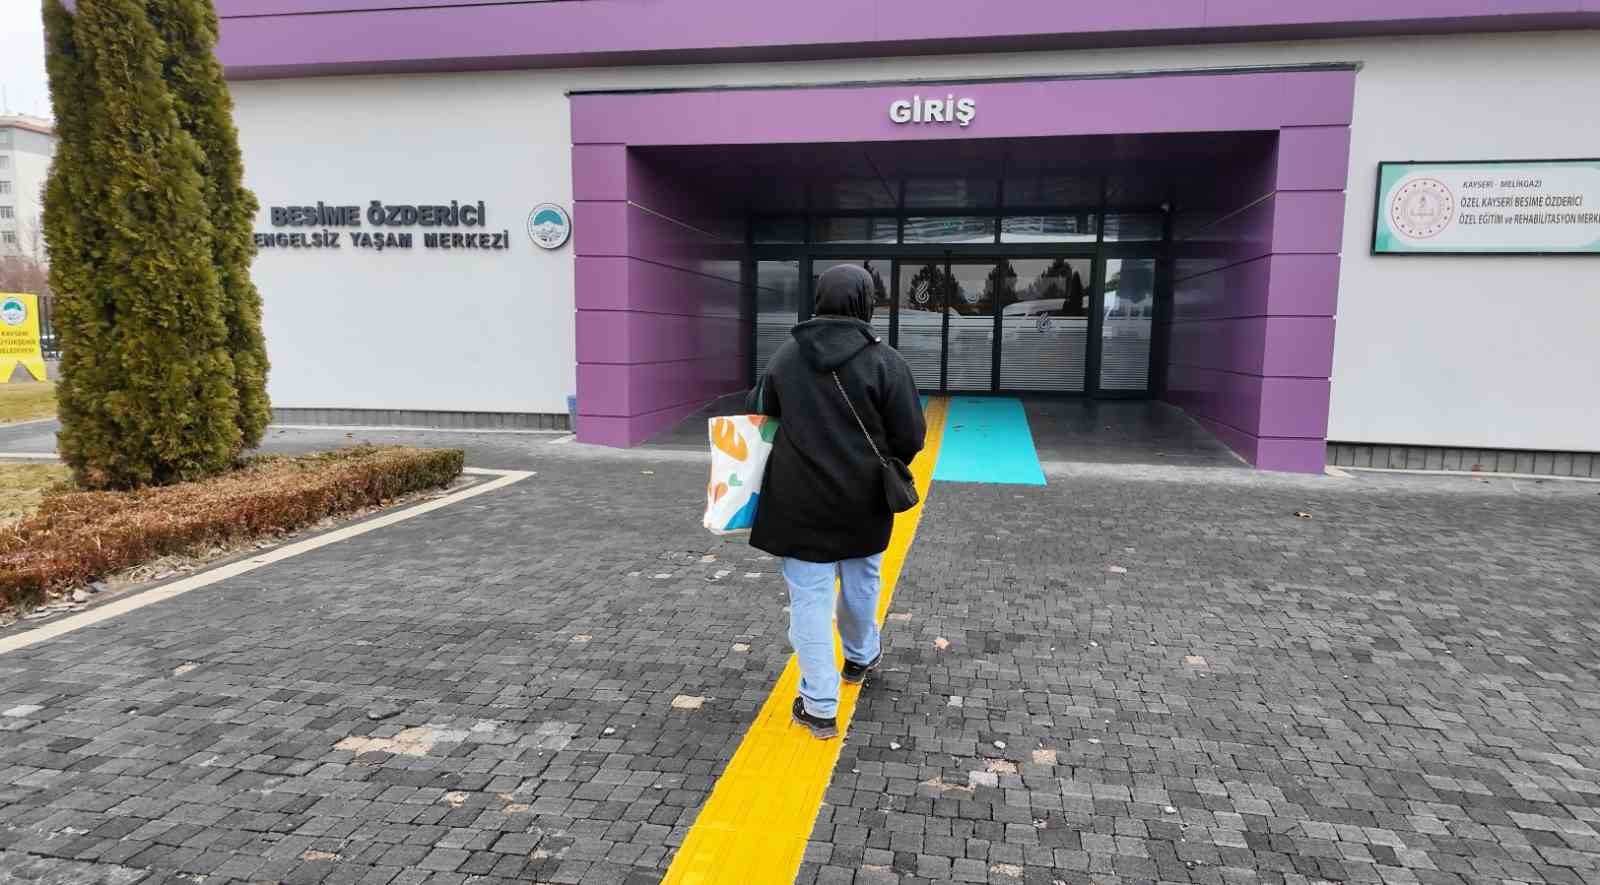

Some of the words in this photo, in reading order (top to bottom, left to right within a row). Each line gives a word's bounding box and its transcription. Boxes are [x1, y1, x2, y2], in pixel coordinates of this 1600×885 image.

[889, 93, 976, 127] GİRİŞ
[1460, 196, 1480, 208] ÖZEL
[270, 200, 361, 227] BESİME
[367, 200, 486, 227] ÖZDERİCİ
[1458, 212, 1476, 225] ÖZEL
[1505, 216, 1512, 225] ve
[1577, 212, 1600, 225] MERK
[254, 229, 340, 248] ENGELSİZ
[350, 231, 413, 251] YAŞAM
[424, 229, 509, 249] MERKEZİ
